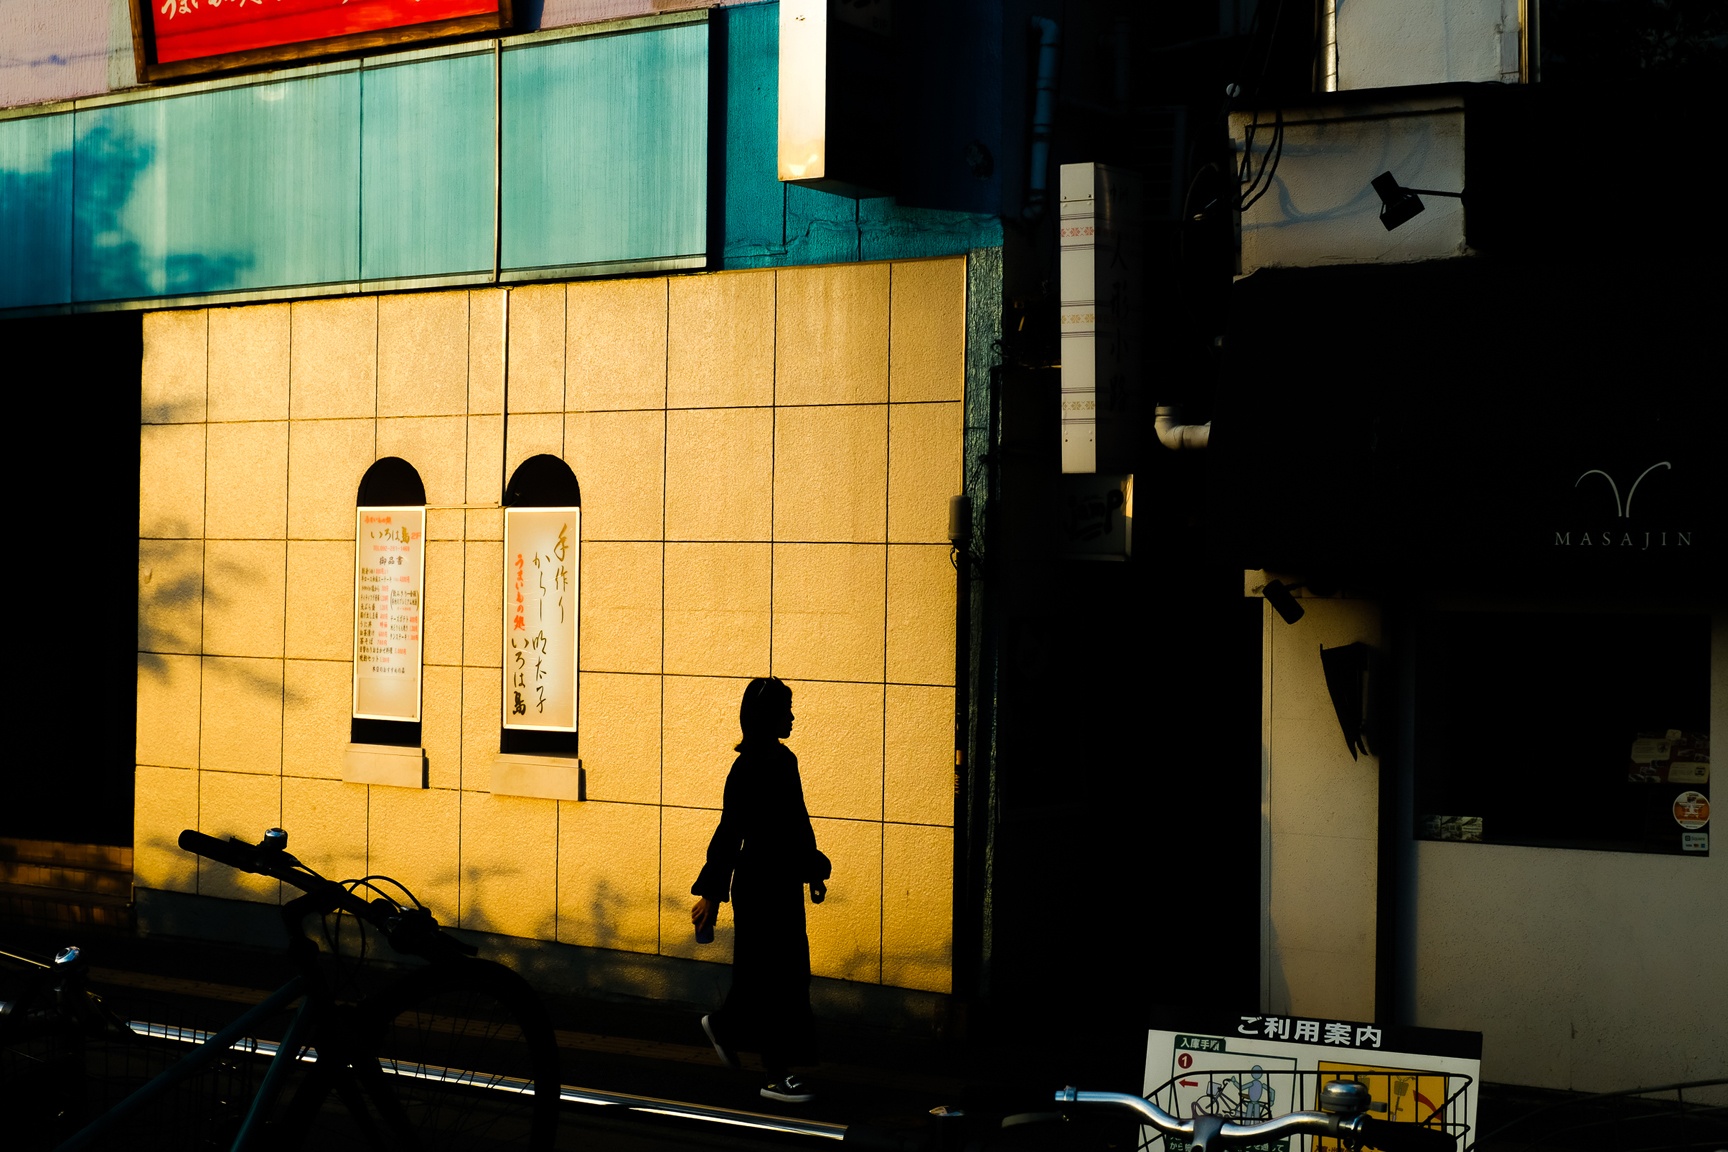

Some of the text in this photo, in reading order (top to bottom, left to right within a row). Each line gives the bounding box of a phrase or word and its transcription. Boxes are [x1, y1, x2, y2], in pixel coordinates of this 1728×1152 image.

[1109, 235, 1130, 413] 人形小路
[370, 526, 410, 544] いろは島
[1554, 531, 1692, 551] MASAJIN
[378, 555, 404, 566] 御品書
[511, 553, 530, 715] うまいもの処 いろは島
[1237, 1016, 1382, 1048] ご利用案内
[1180, 1037, 1220, 1051] 入庫手順
